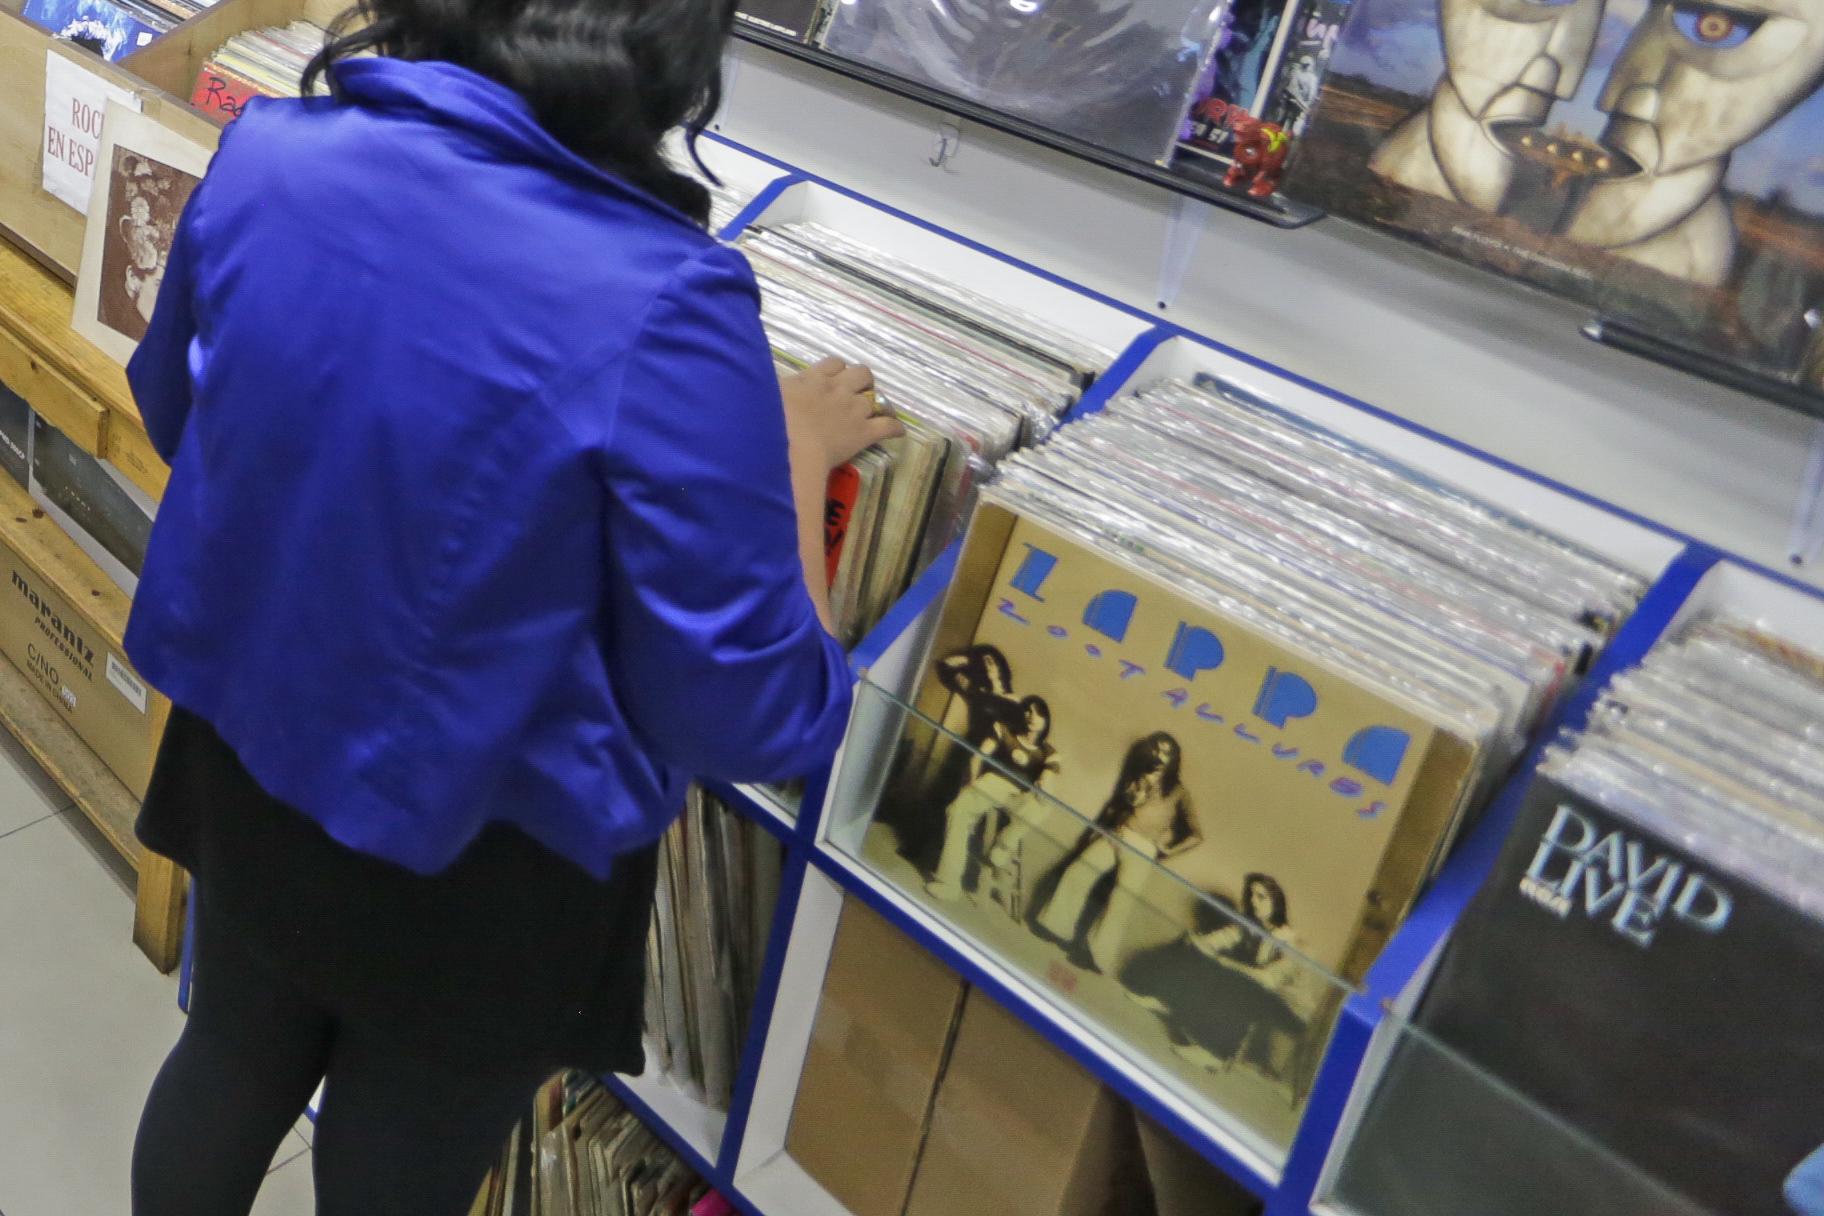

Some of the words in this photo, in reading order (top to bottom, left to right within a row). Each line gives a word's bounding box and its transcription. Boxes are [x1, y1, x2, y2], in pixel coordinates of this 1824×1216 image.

[48, 126, 65, 159] EN
[69, 138, 95, 177] ESP
[72, 97, 104, 141] ROC
[12, 569, 96, 669] marantz
[34, 615, 94, 683] PROFESSIONAL
[997, 597, 1146, 679] ZOOT
[1526, 840, 1657, 949] LIVE
[1542, 803, 1734, 931] DAVID
